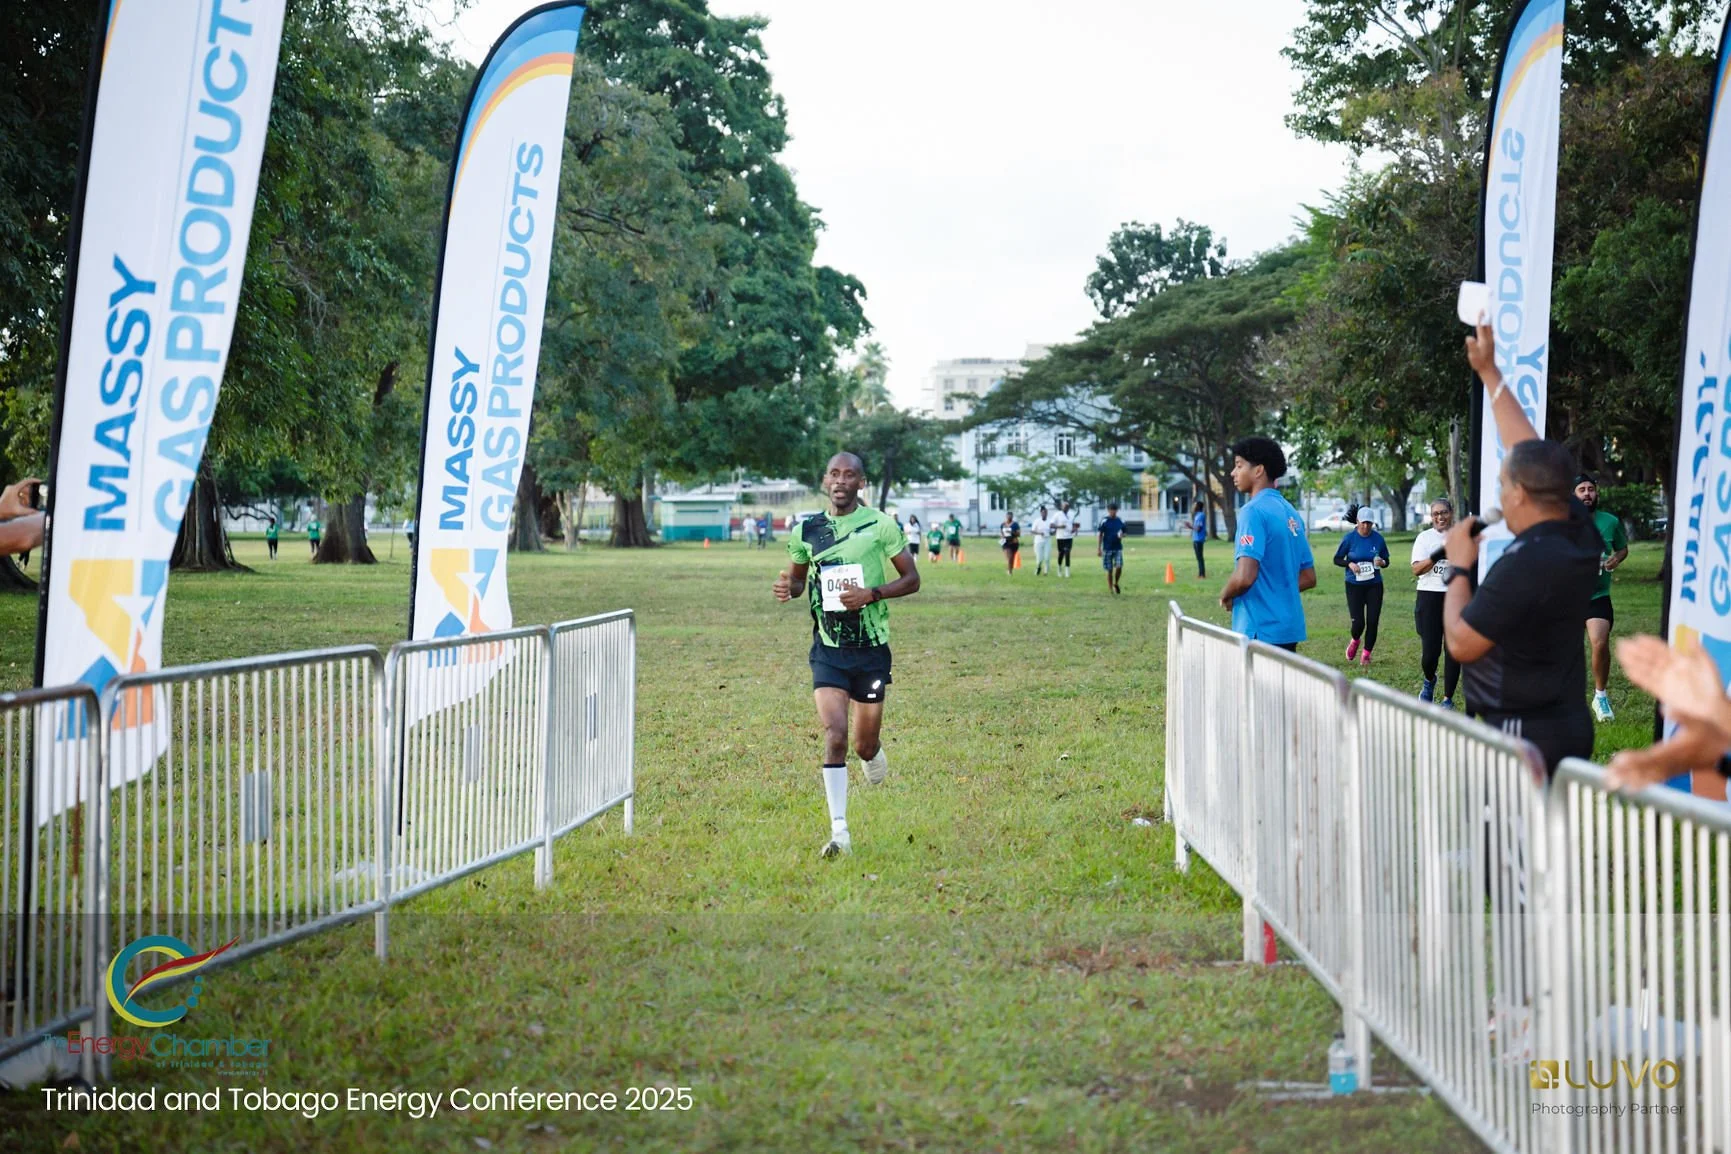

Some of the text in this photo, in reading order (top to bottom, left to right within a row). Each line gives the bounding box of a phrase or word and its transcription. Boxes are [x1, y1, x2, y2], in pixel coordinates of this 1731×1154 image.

[165, 0, 253, 363] PRODUCT
[480, 142, 544, 532] GAS PRODUCTS
[83, 253, 156, 531] MASSY
[439, 345, 480, 531] MASSY
